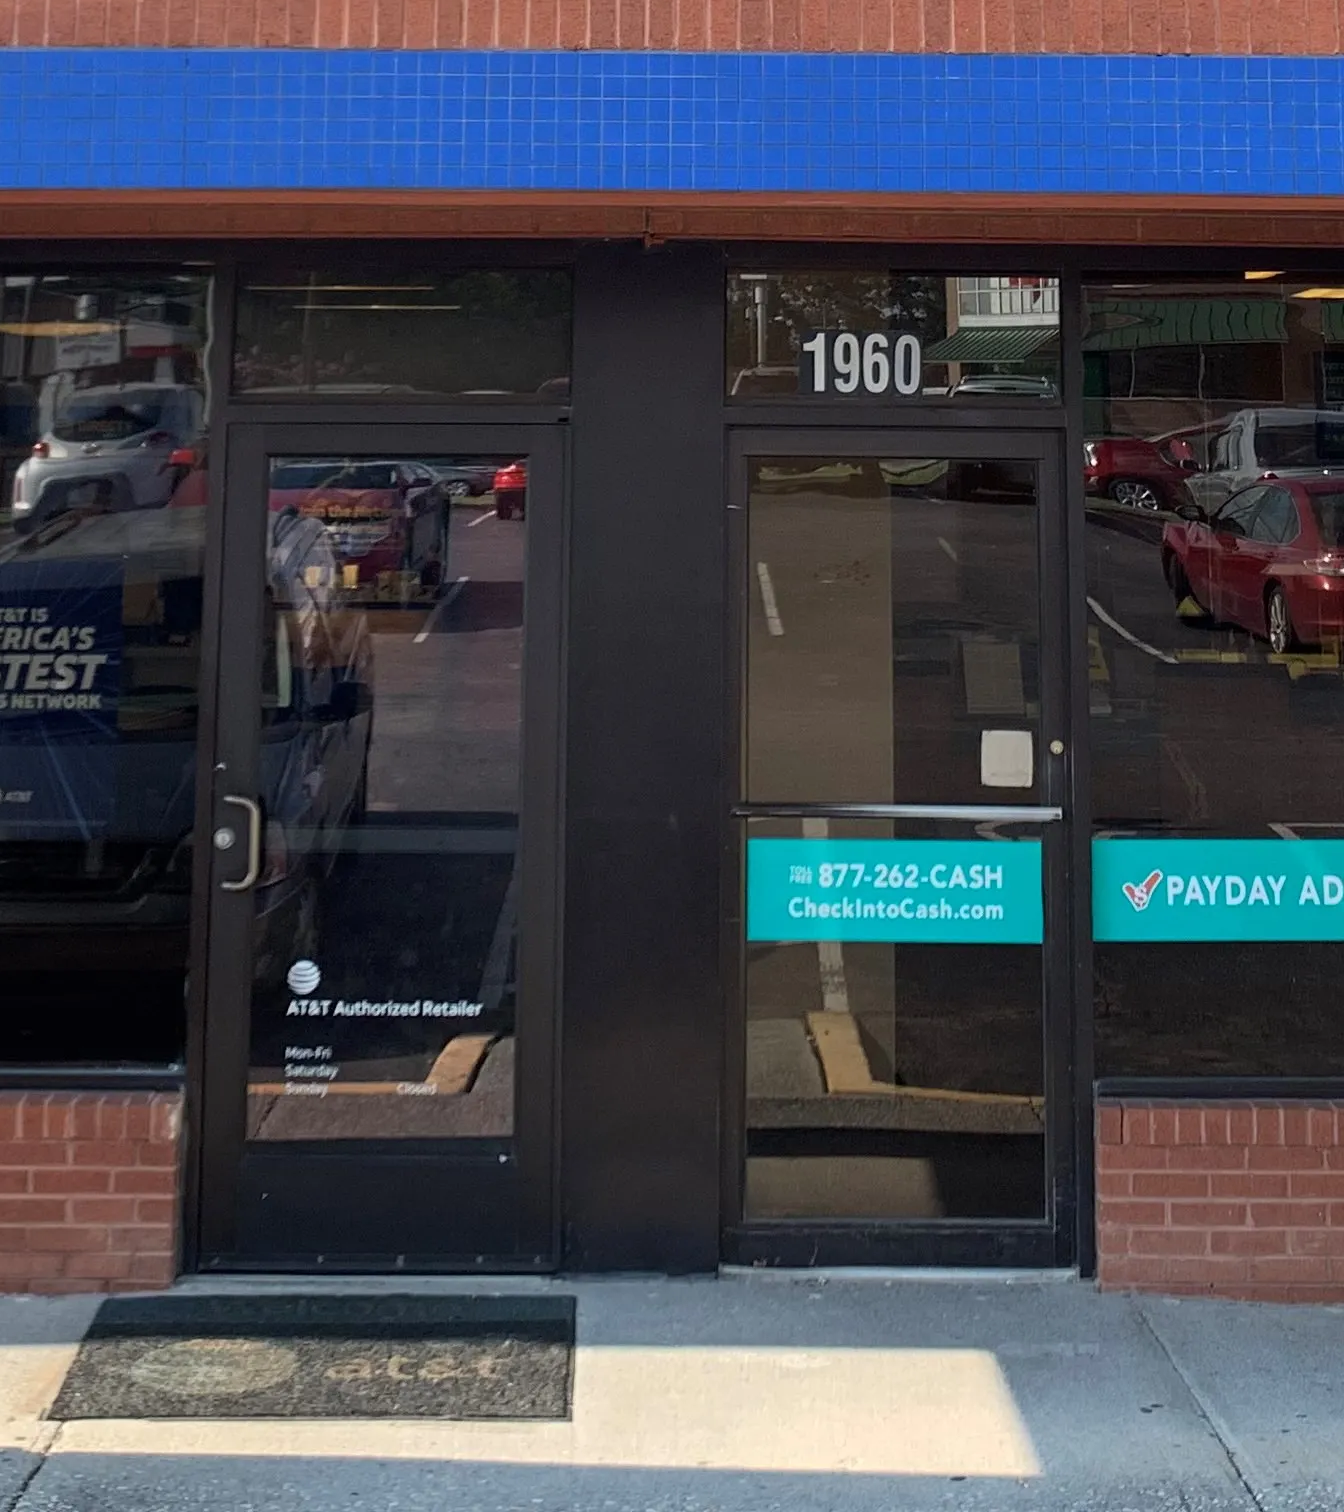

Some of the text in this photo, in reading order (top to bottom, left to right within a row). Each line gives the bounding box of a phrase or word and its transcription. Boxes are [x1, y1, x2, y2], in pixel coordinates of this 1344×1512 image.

[803, 333, 921, 394] 1960
[29, 608, 49, 623] IS
[10, 694, 103, 709] NETWORK
[818, 863, 1003, 889] 877-262-CASH
[1166, 875, 1287, 906] PAYDAY
[788, 896, 1004, 920] CheckIntoCash.com
[286, 999, 484, 1017] AT&T Authorized Retailer
[285, 1063, 339, 1080] Saturday
